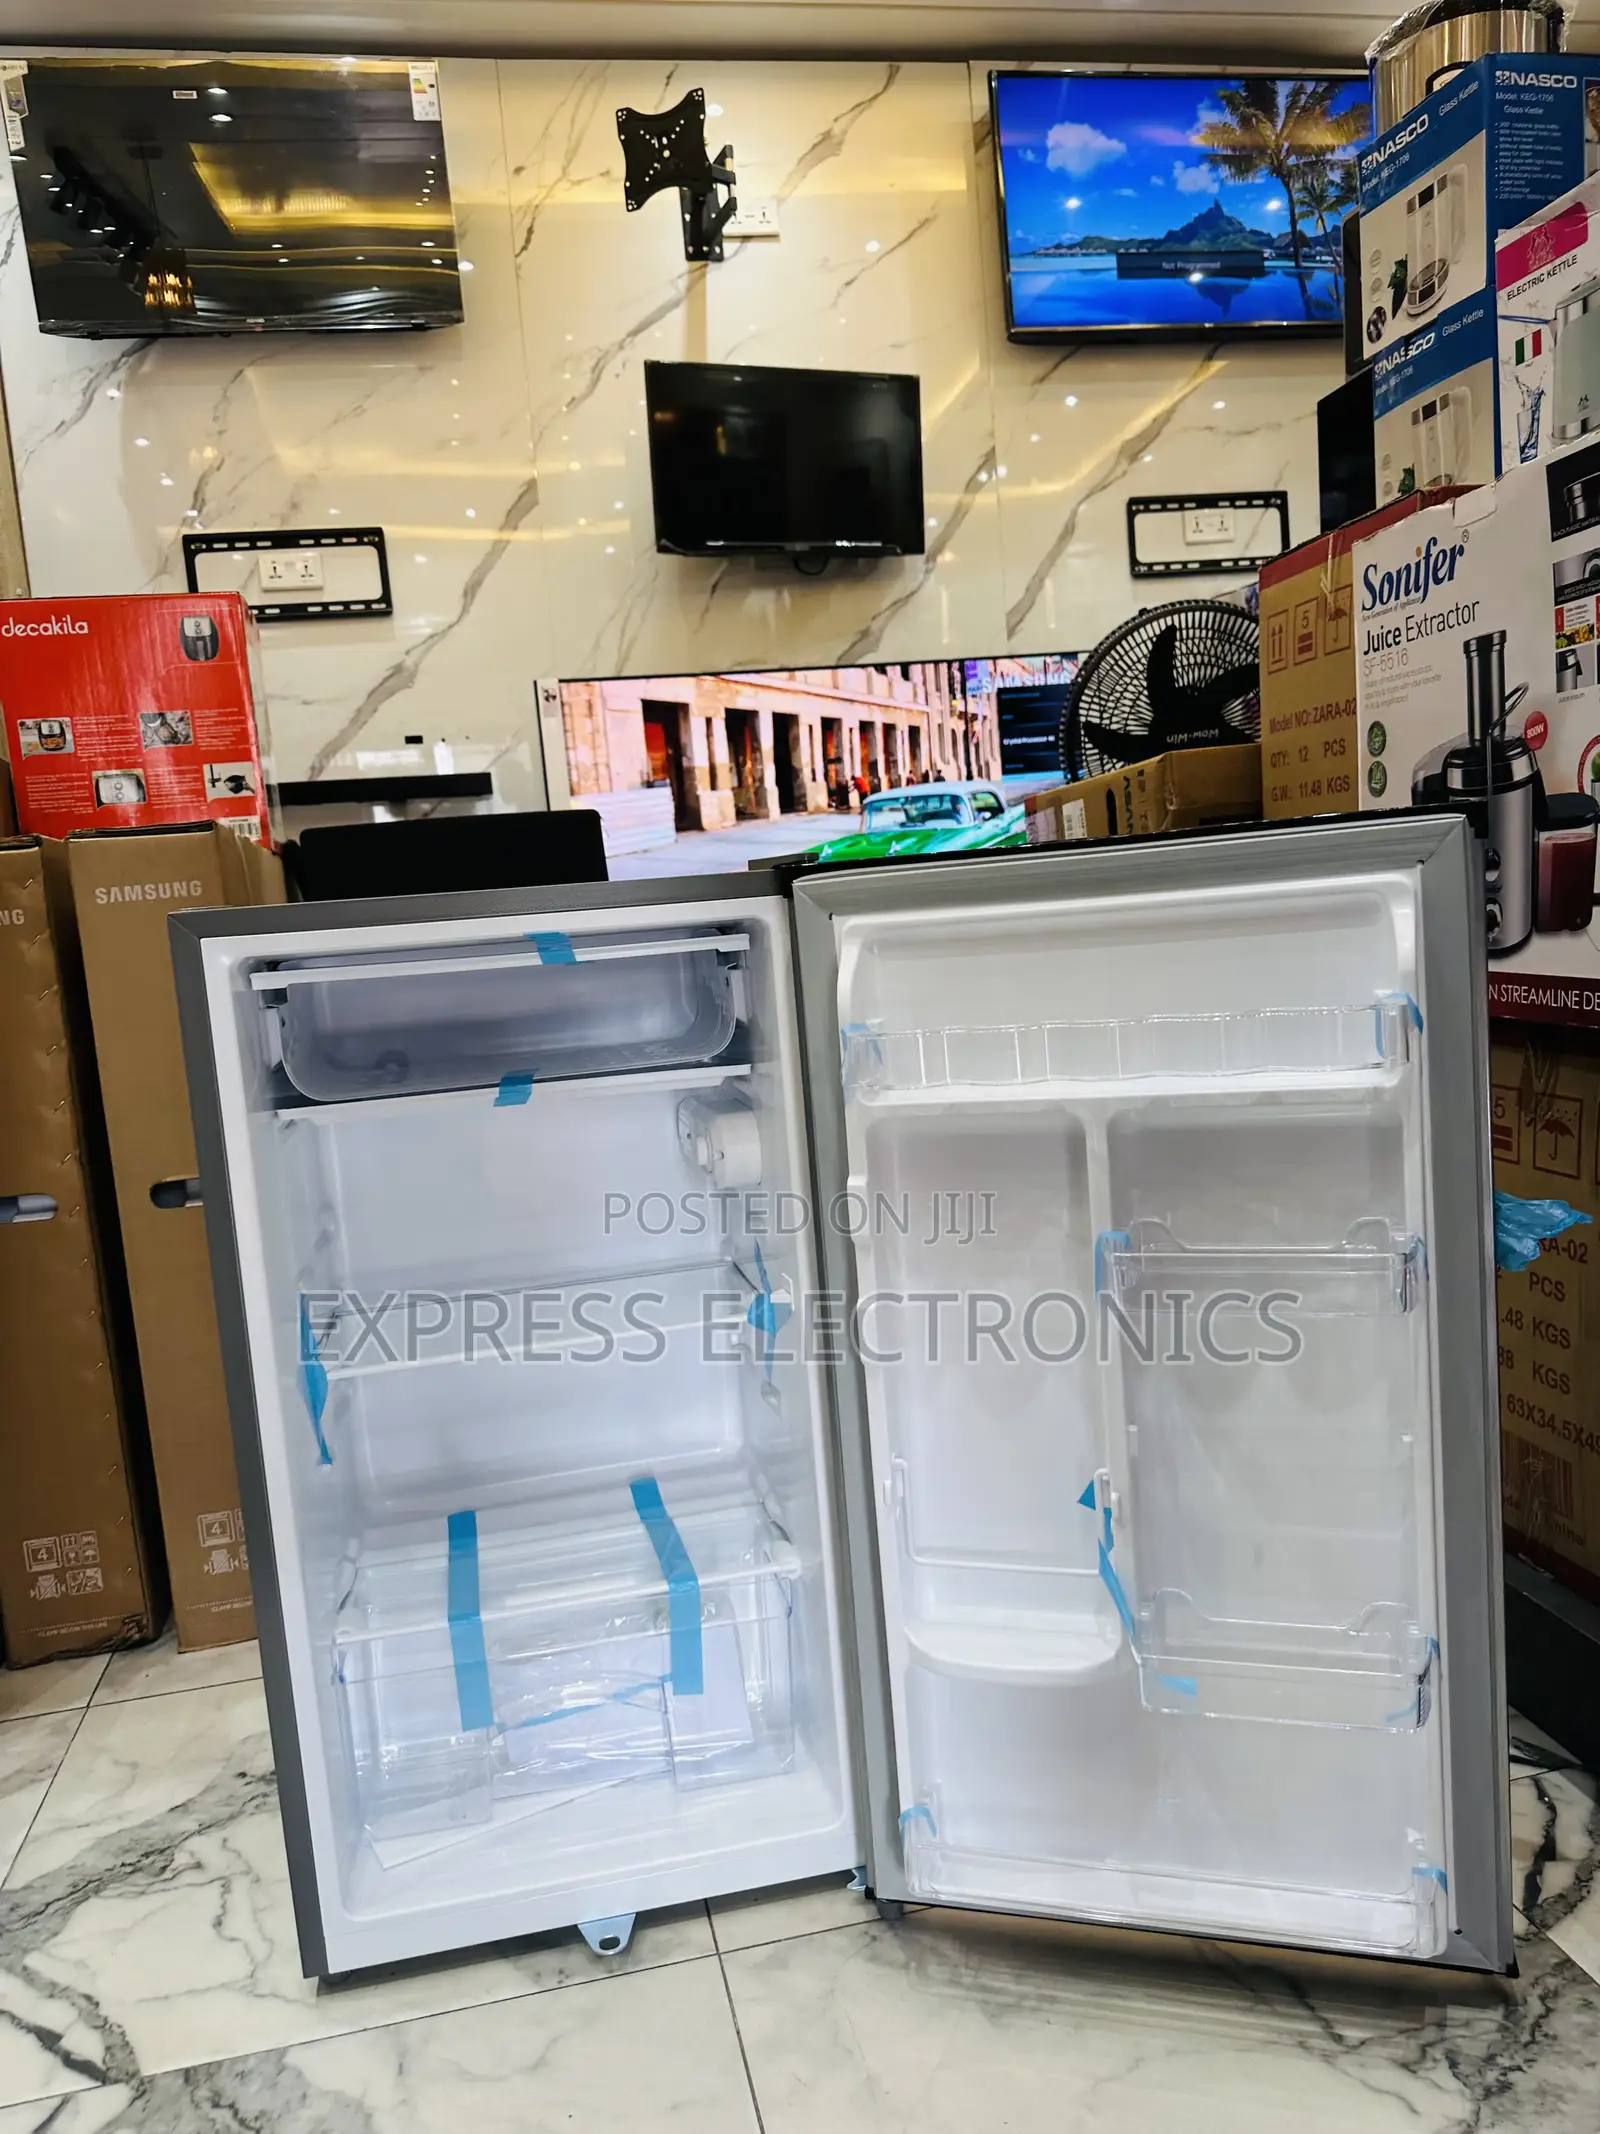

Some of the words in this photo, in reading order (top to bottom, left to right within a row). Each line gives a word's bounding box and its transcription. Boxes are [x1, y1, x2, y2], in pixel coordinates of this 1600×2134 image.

[1511, 71, 1577, 89] NASCO
[1438, 98, 1459, 116] Glass
[1459, 80, 1479, 101] Kettle
[1372, 113, 1429, 168] NASCO
[1507, 273, 1545, 301] ELECTRIC
[1546, 254, 1578, 280] KETTLE
[1442, 321, 1461, 337] Glass
[1462, 309, 1484, 325] Kettle
[1381, 332, 1436, 375] NASCO
[1361, 536, 1465, 613] Sonifer
[1, 614, 89, 637] decakila
[1363, 625, 1402, 656] Juice
[1405, 601, 1480, 642] Extractor
[1269, 711, 1293, 734] Model
[1270, 749, 1290, 768] QTY:
[1323, 738, 1346, 758] PCS
[1326, 775, 1350, 794] KGS
[95, 880, 202, 904] SAMSUNG
[1500, 984, 1580, 1009] STREAMLINE
[1528, 1271, 1566, 1302] PCS
[1532, 1316, 1571, 1350] KGS
[1532, 1360, 1571, 1395] KGS
